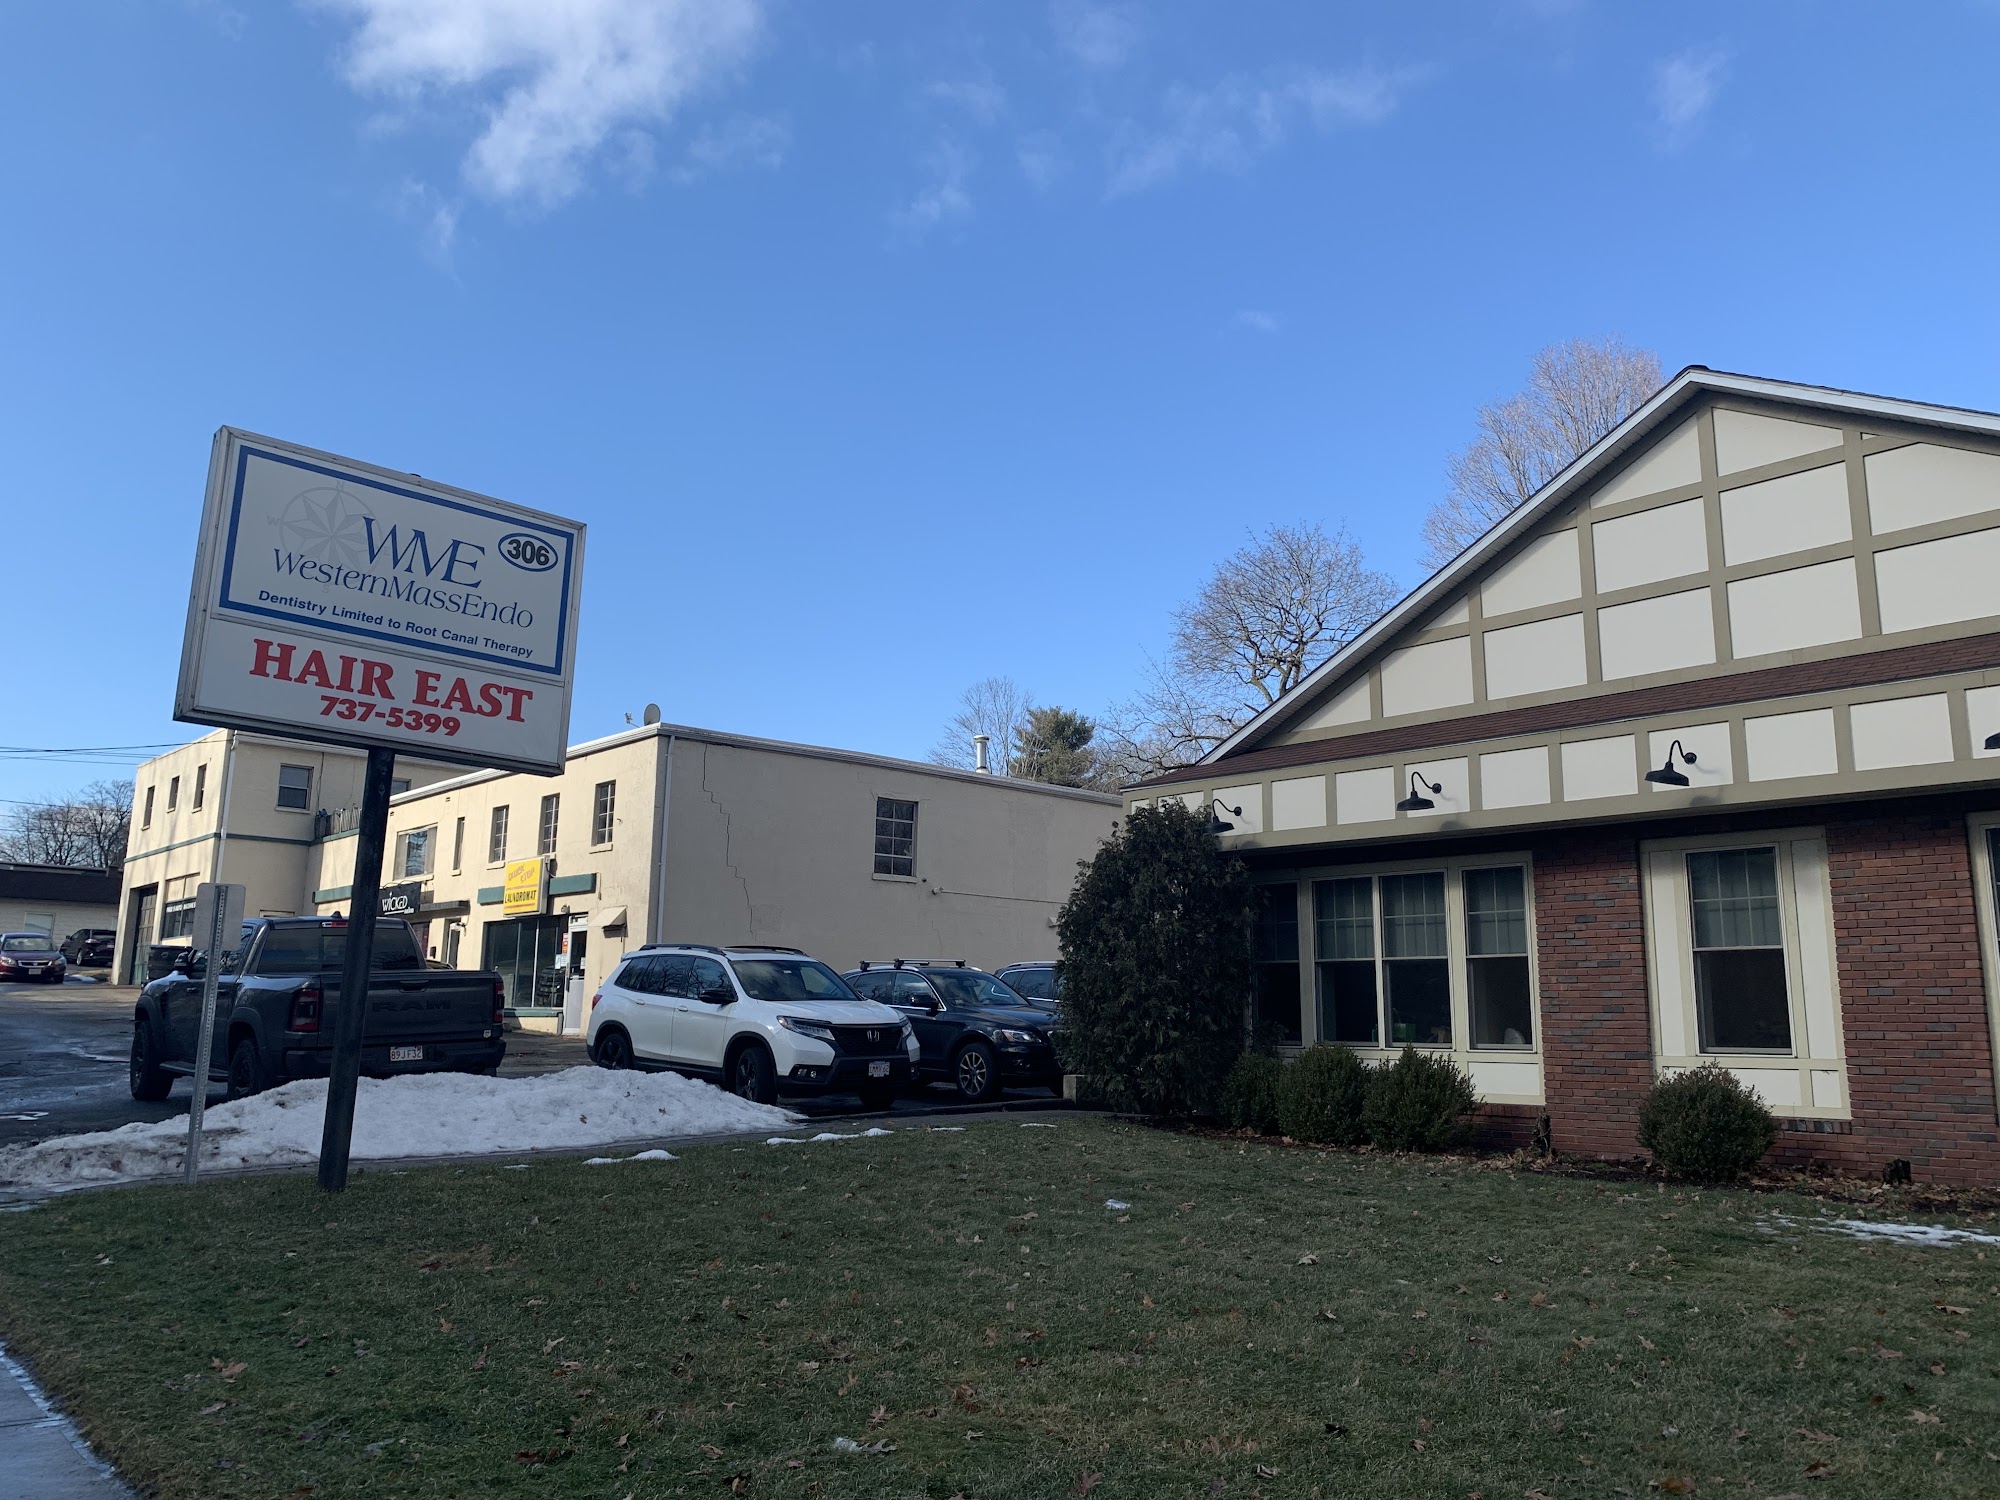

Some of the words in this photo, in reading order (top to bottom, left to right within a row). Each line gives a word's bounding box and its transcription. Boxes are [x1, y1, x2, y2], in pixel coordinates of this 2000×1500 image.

[336, 480, 345, 490] N
[266, 515, 282, 527] W
[362, 516, 485, 588] WME
[506, 539, 550, 566] 306
[273, 548, 533, 628] WesternMassEndo
[258, 590, 327, 615] Dentistry
[332, 605, 383, 626] Limited
[388, 617, 401, 629] to
[405, 621, 437, 637] Root
[441, 629, 478, 646] Canal
[483, 638, 533, 659] Therapy
[249, 638, 395, 700] HAIR
[412, 669, 533, 722] EAST
[320, 695, 461, 736] 737-5399
[504, 890, 537, 904] LAUNDROMAT
[372, 999, 452, 1012] RAM
